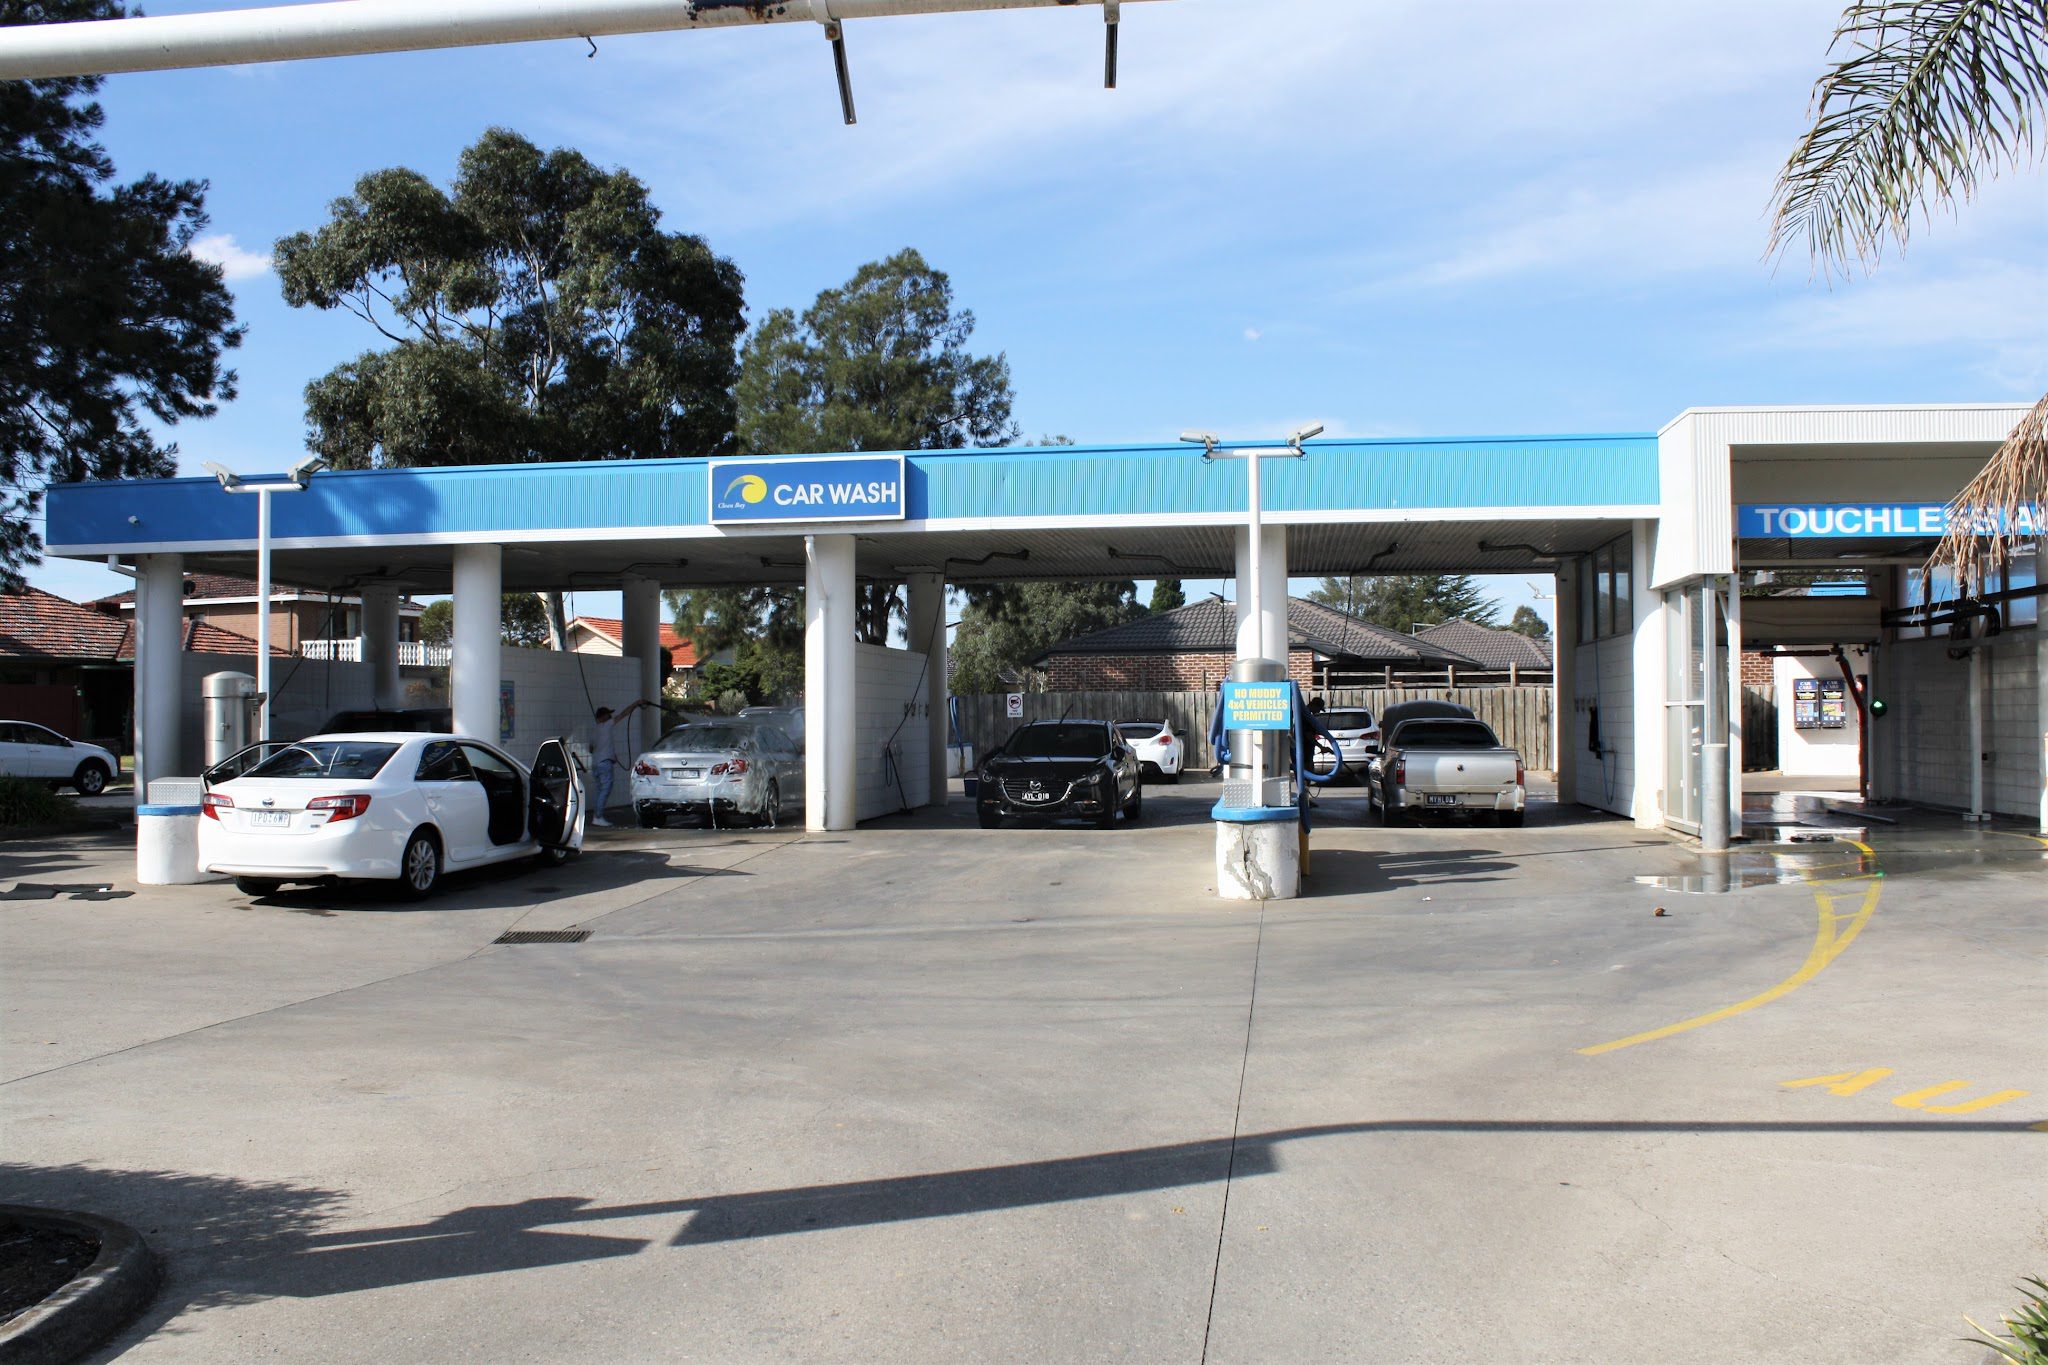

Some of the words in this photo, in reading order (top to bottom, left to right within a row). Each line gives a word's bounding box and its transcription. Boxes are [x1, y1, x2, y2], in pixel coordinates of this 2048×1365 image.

[773, 484, 824, 505] CAR
[829, 482, 896, 503] WASH
[1234, 688, 1247, 699] NO
[1249, 688, 1282, 699] MUDDY
[1246, 699, 1288, 710] VEHICLES
[1233, 711, 1283, 721] PERMITTED
